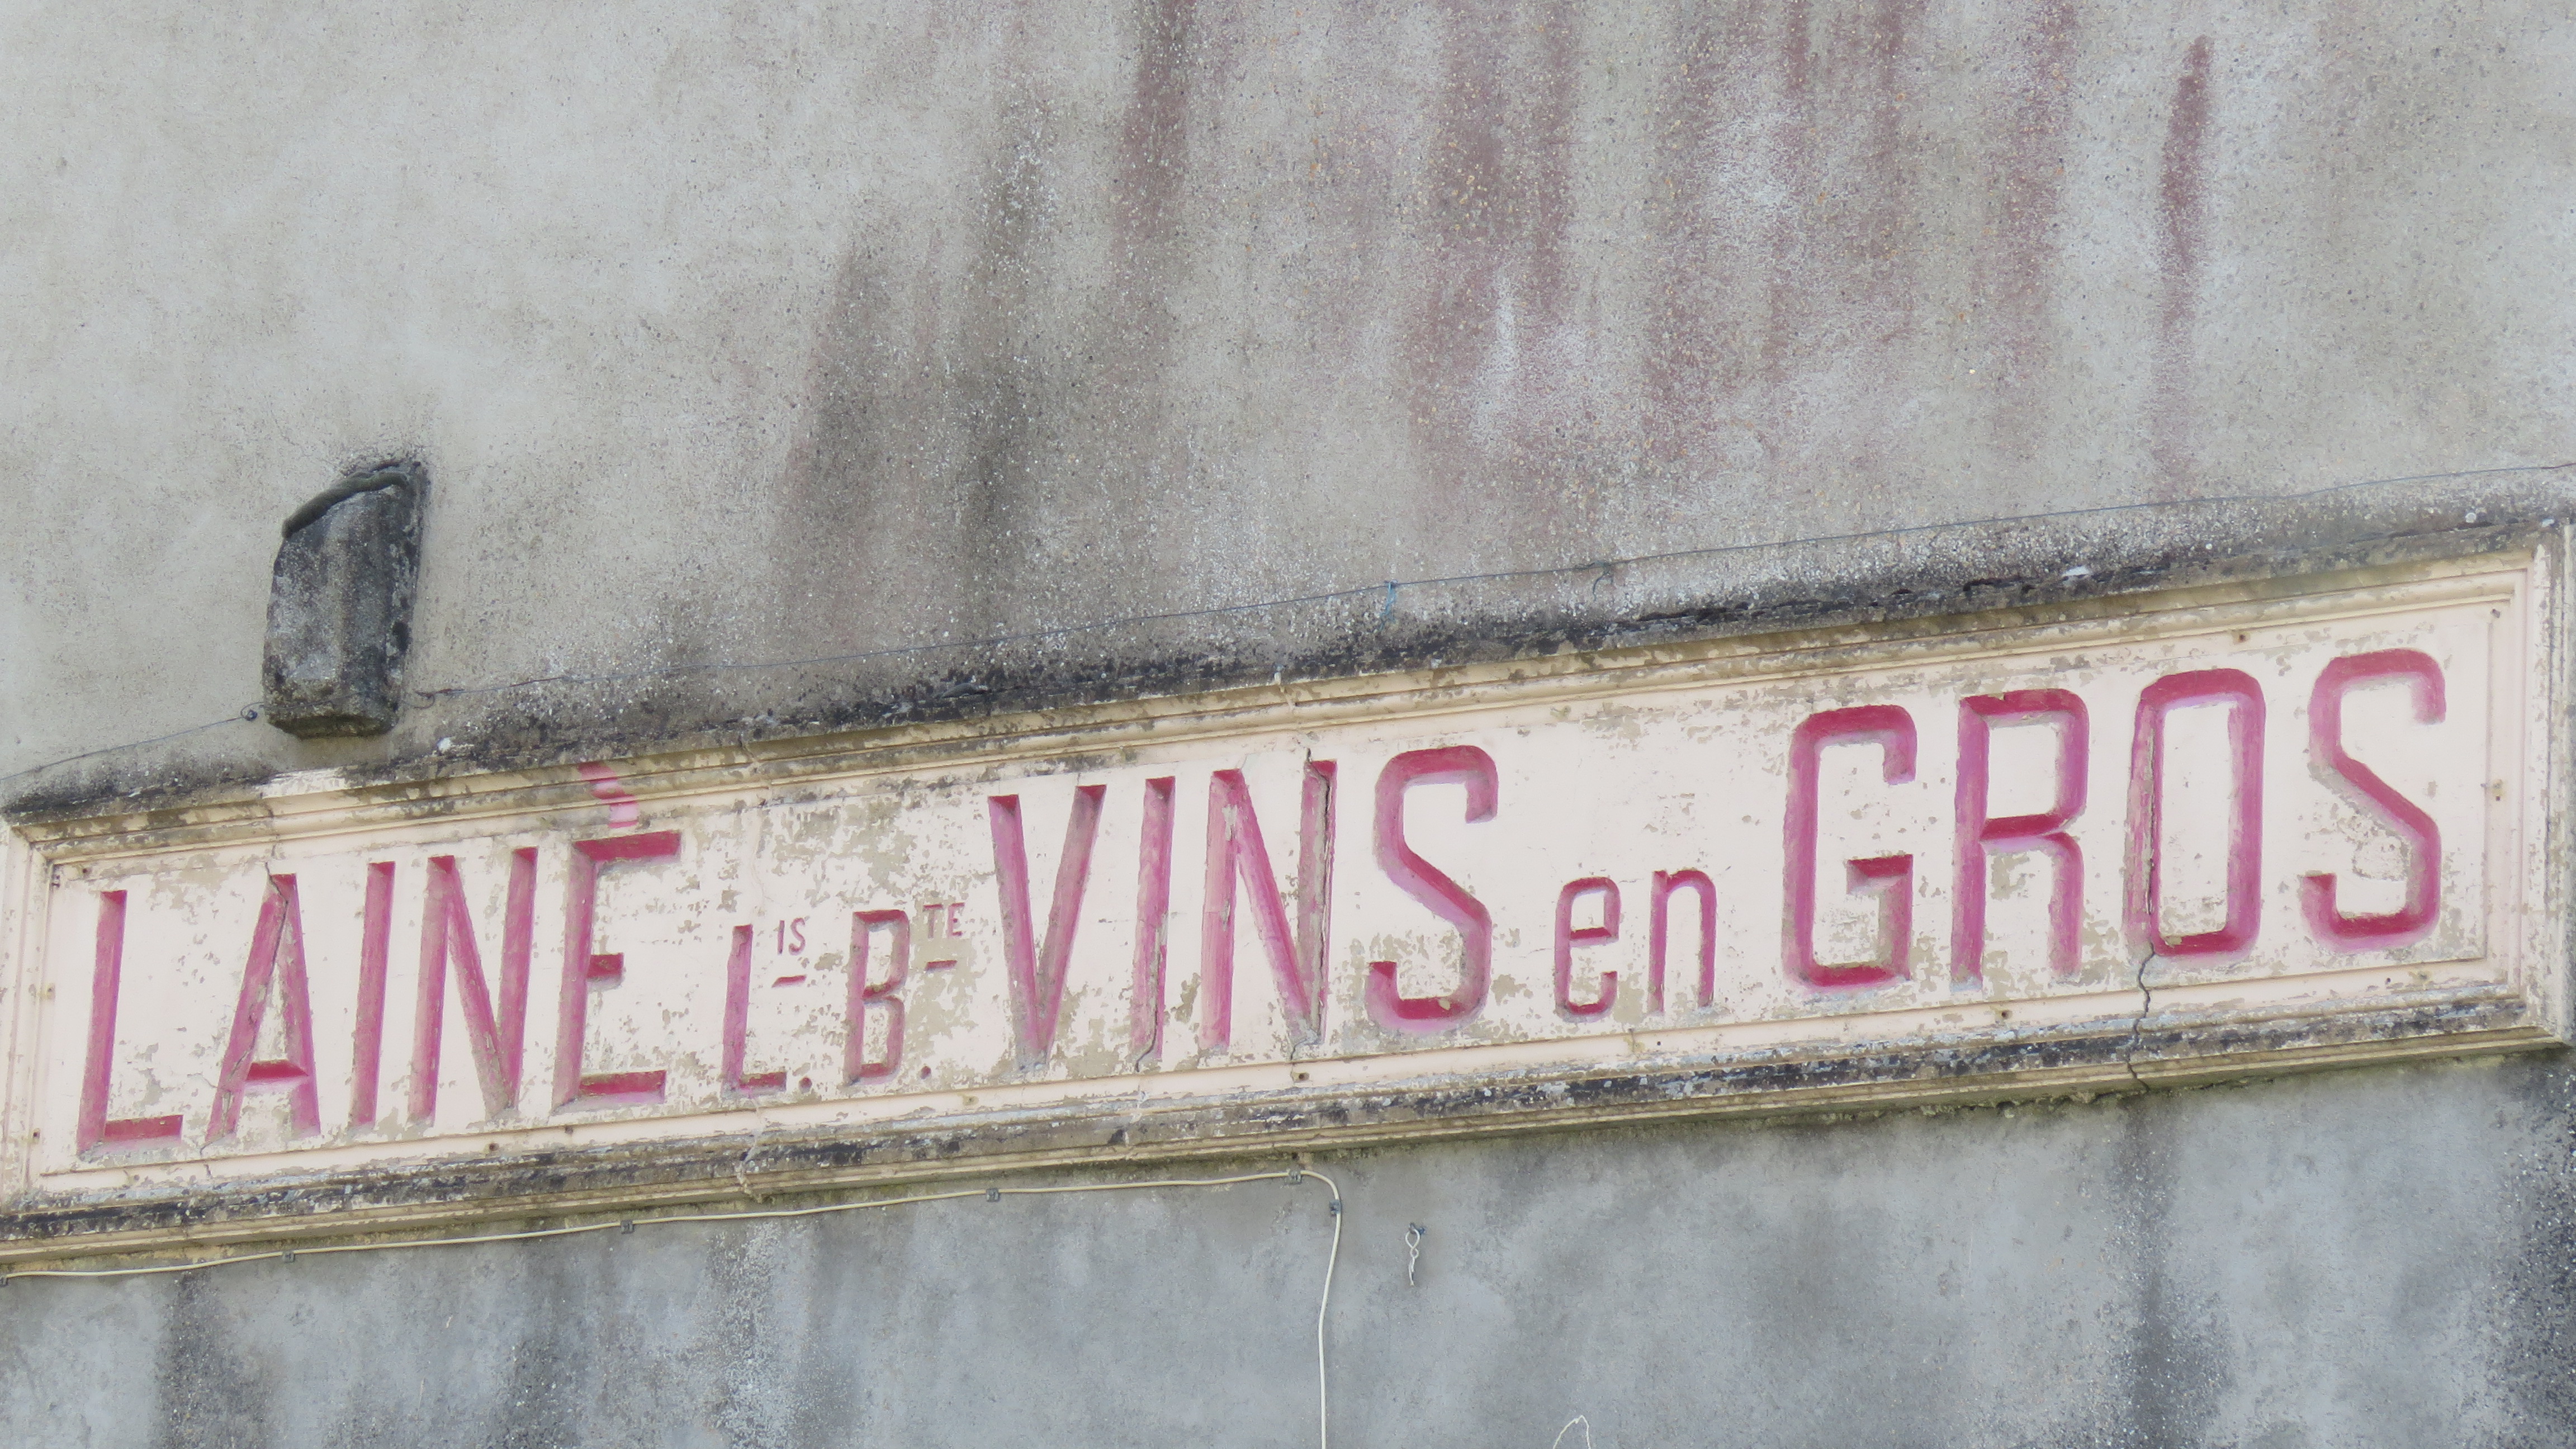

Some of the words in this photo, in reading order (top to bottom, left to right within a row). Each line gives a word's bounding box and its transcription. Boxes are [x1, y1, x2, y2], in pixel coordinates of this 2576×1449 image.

[988, 745, 1498, 1069] VINS
[1554, 869, 1716, 1020] en
[1783, 648, 2446, 989] GROS
